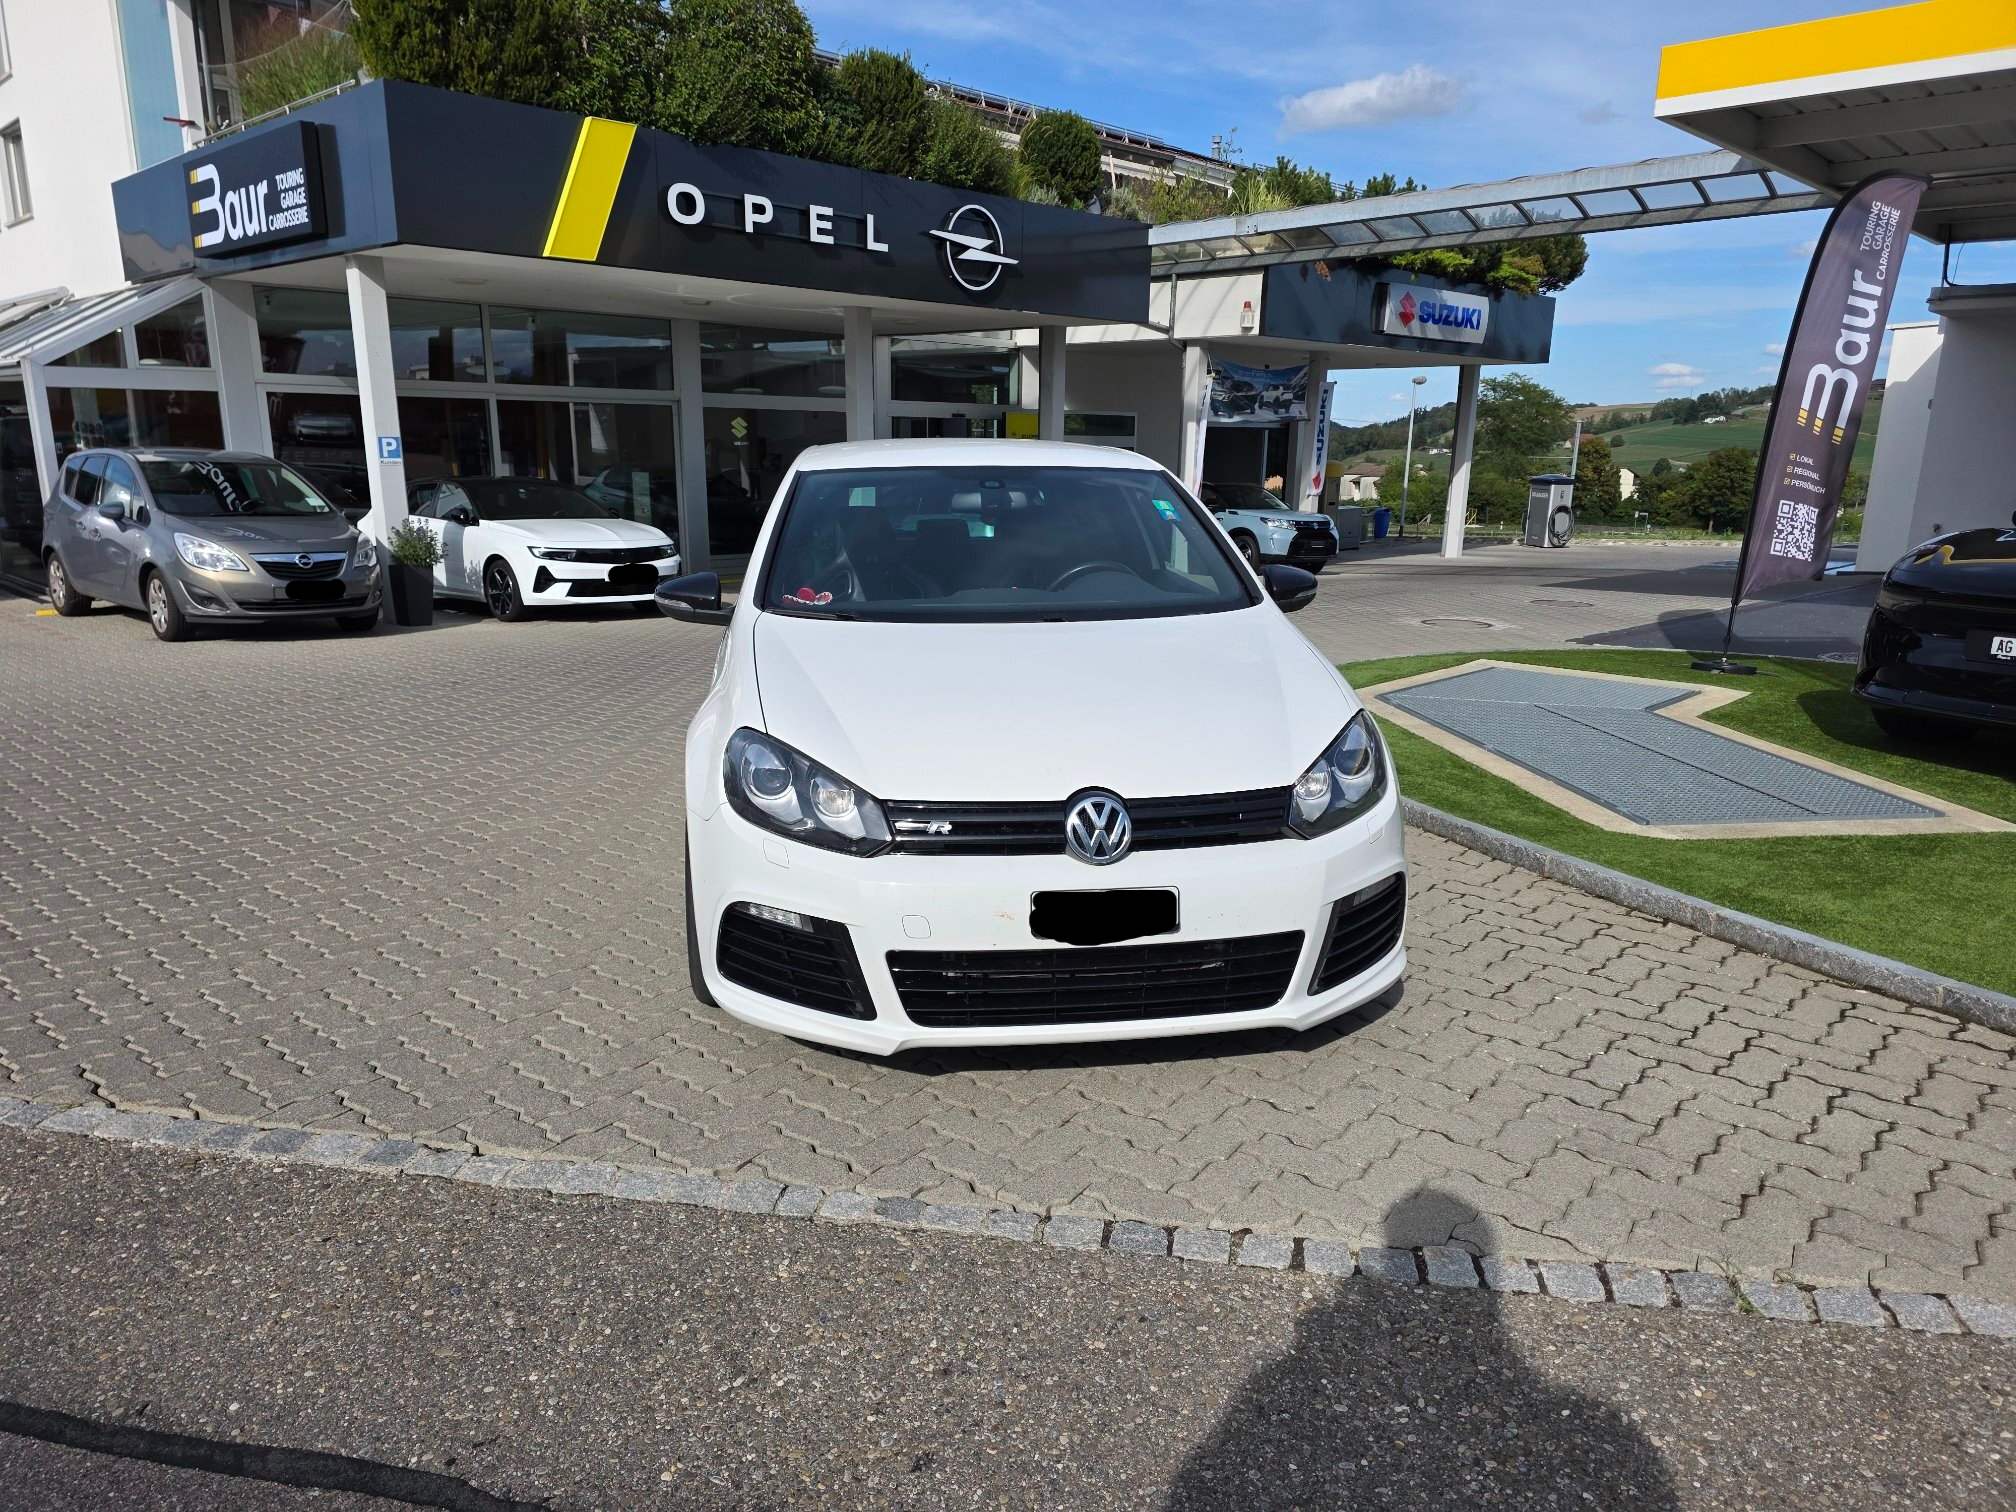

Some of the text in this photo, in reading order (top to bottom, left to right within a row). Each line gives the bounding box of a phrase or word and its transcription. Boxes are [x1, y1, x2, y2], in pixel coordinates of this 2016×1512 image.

[275, 167, 304, 191] TOURING
[189, 163, 268, 249] Baur
[280, 186, 306, 209] GARAGE
[268, 205, 309, 231] CARROSSERIE
[667, 182, 889, 253] OPEL
[1860, 200, 1881, 251] TOURING
[1872, 204, 1892, 250] GARAGE
[1876, 207, 1901, 280] CARROSSERIE
[1418, 300, 1483, 331] SUZUKI
[1797, 269, 1883, 445] Baur
[1316, 388, 1329, 466] SUZUKI
[381, 437, 398, 458] P
[1796, 454, 1815, 466] LOKAL
[1793, 466, 1821, 481] REGIONAL
[1995, 639, 2014, 654] AG
